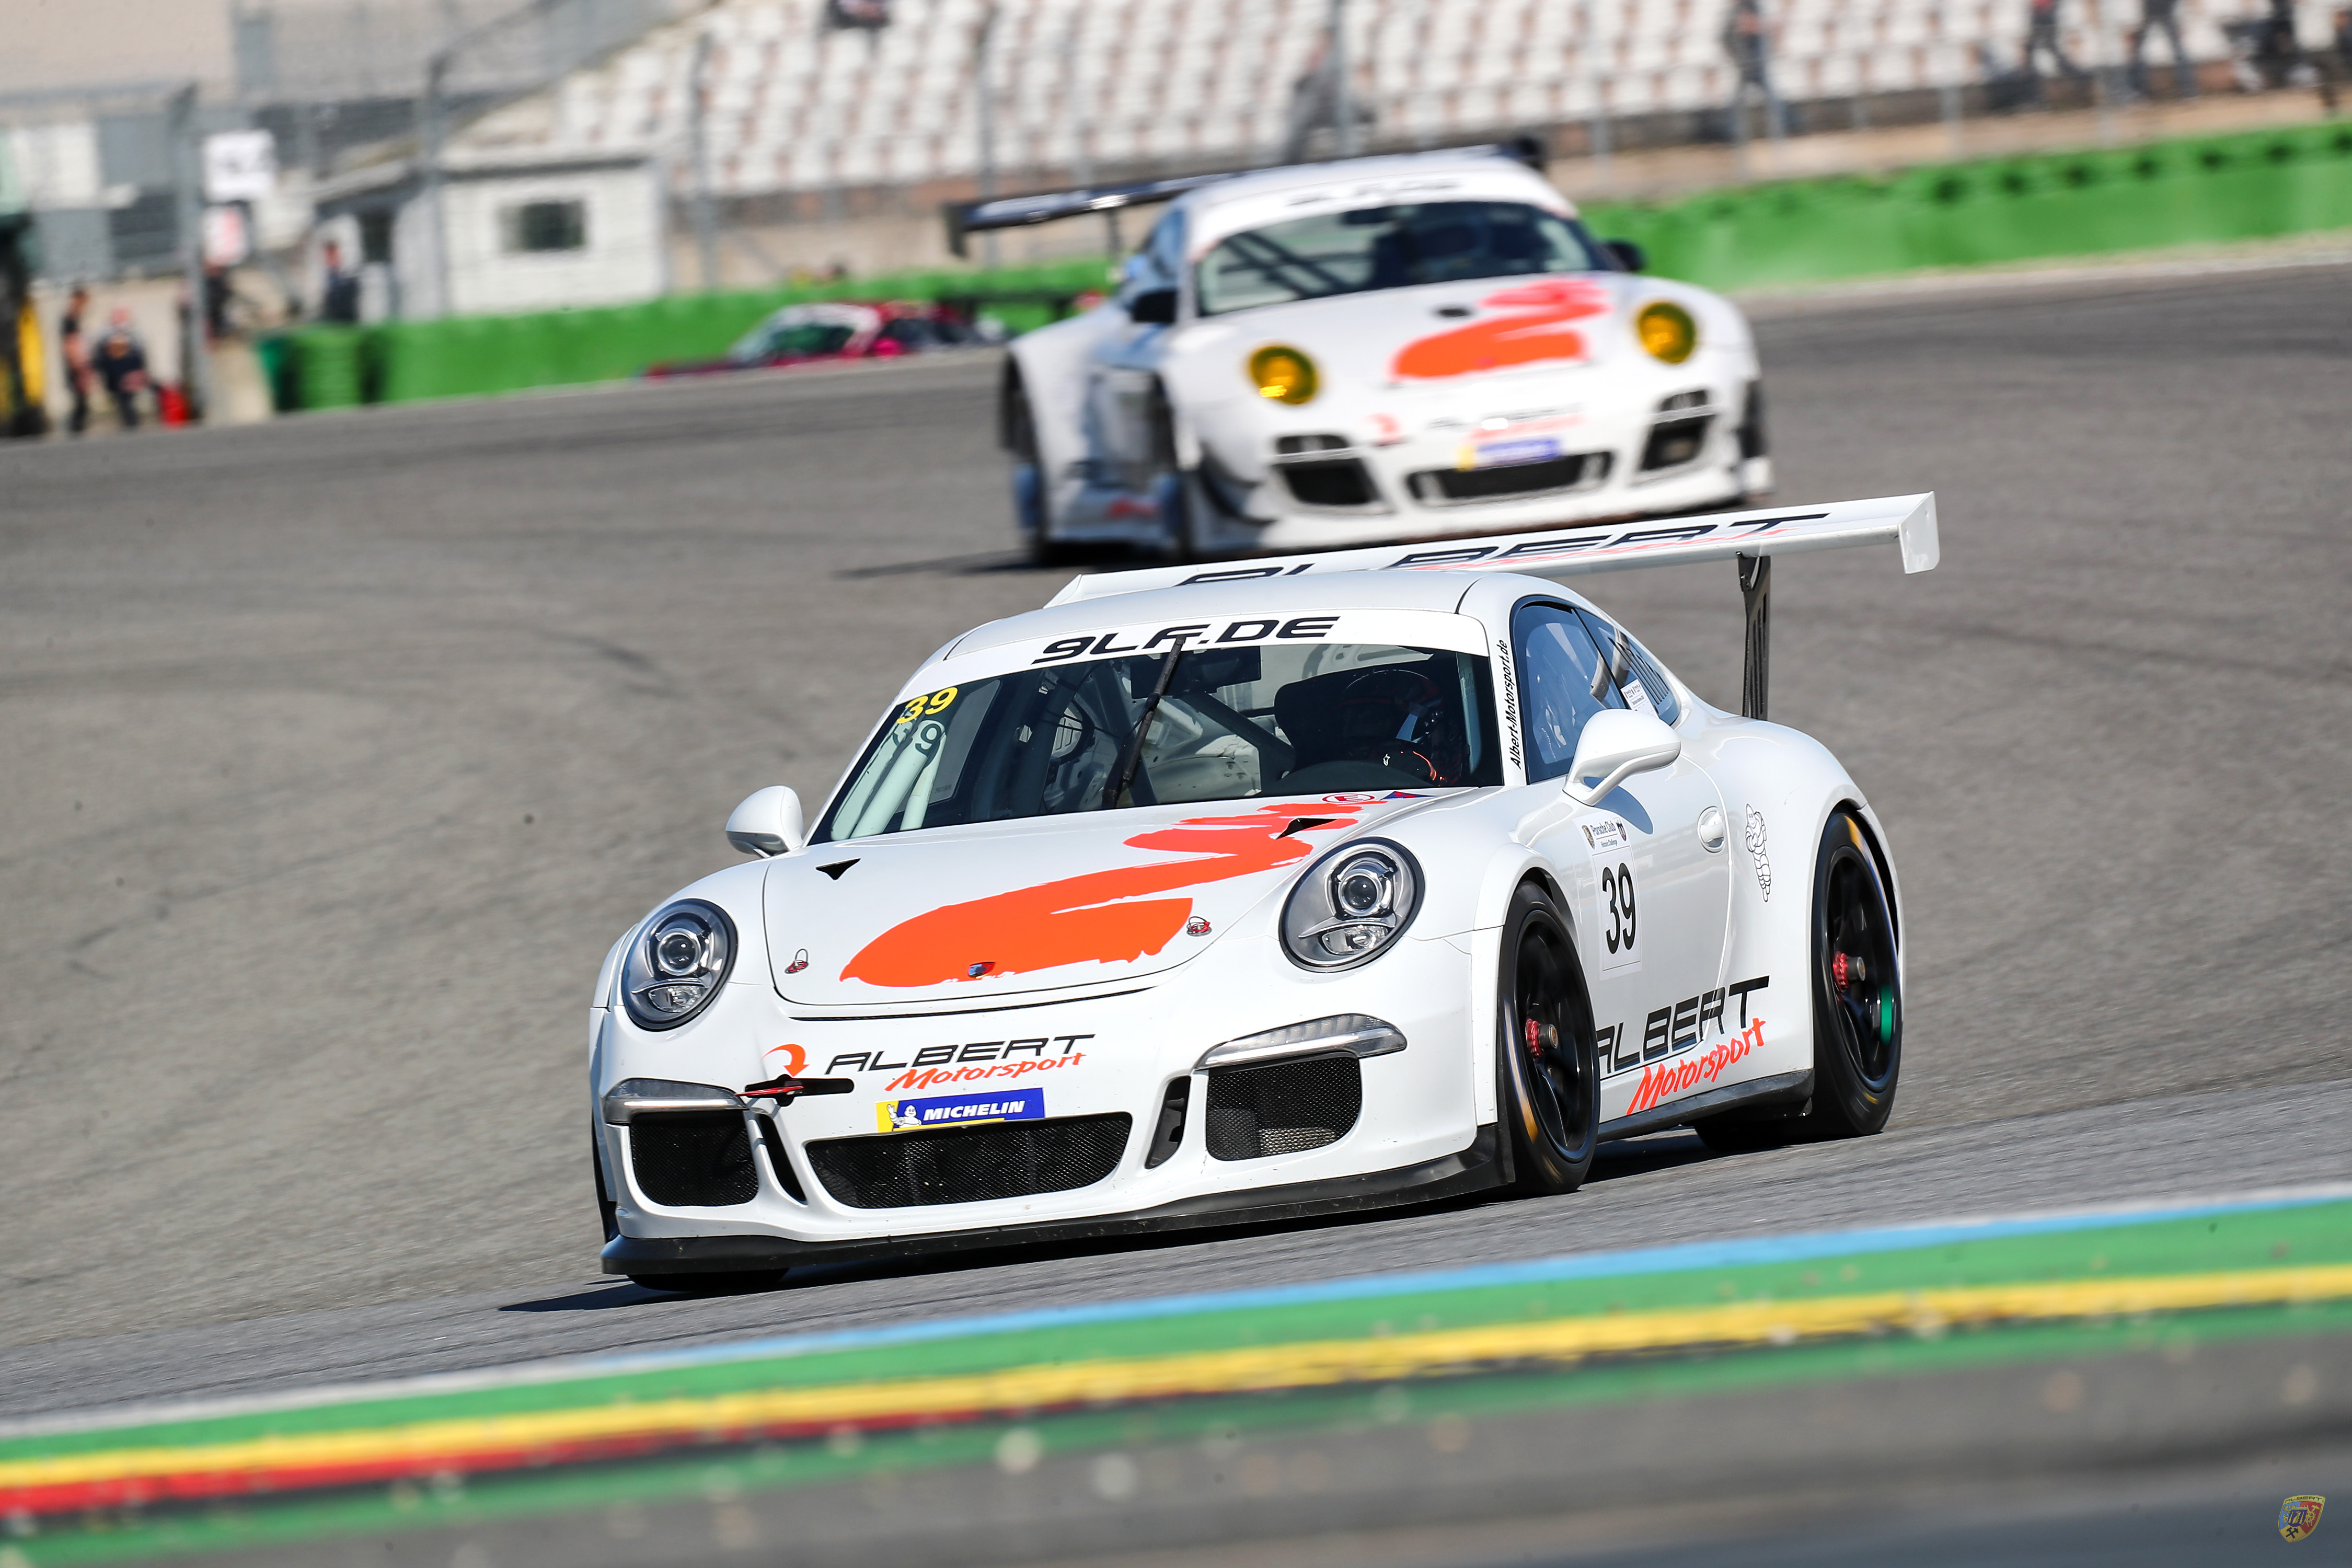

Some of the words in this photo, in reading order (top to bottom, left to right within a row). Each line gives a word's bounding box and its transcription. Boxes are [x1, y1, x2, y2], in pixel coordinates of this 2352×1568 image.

[1410, 527, 1800, 570] otorsport
[896, 687, 959, 724] 39
[1496, 639, 1521, 770] Albert-Motorsport.de
[1602, 862, 1636, 954] 39
[1596, 975, 1770, 1074] ALBERT
[825, 1034, 1096, 1075] ALBERT
[884, 1052, 1087, 1091] Motorsport
[1625, 1018, 1766, 1116] Motorsport
[923, 1100, 1025, 1121] MICHELIN
